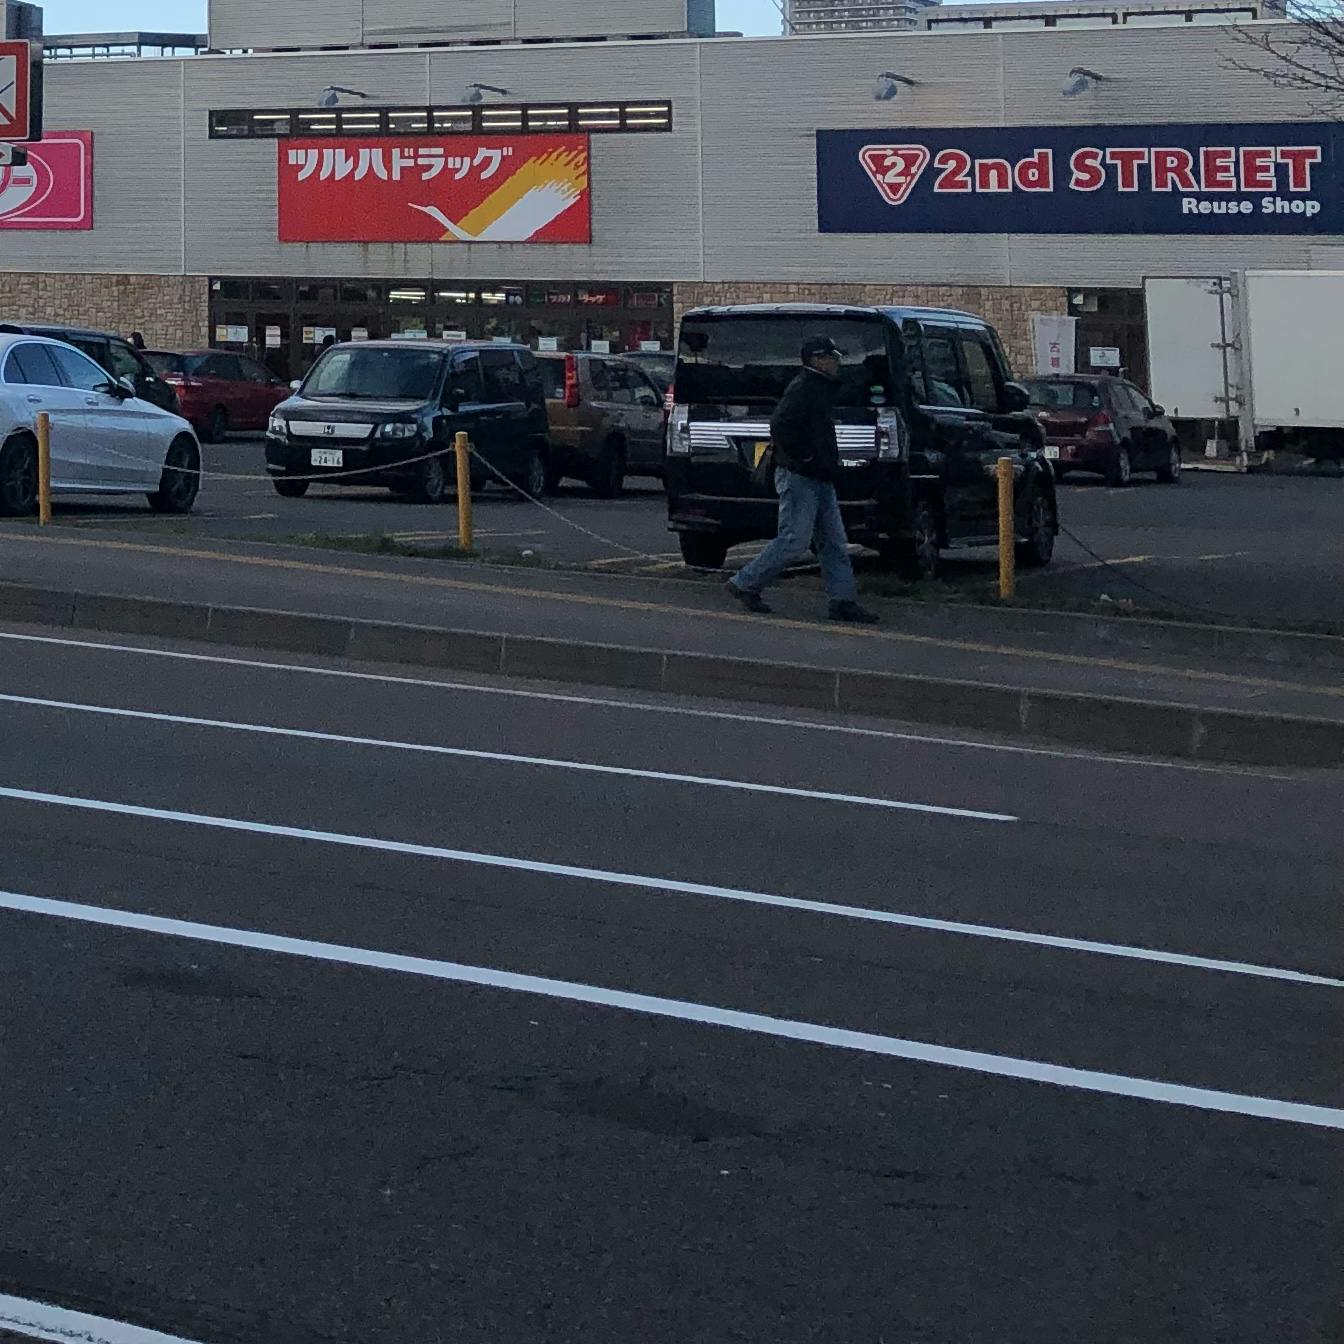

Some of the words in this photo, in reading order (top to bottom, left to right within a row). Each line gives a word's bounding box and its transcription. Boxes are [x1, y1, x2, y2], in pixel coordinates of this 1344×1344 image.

[287, 146, 513, 181] ツルハドラッグ
[933, 147, 1054, 193] 2nd
[1069, 145, 1322, 193] STREET
[1181, 197, 1254, 214] Reuse
[1261, 197, 1322, 217] Shop
